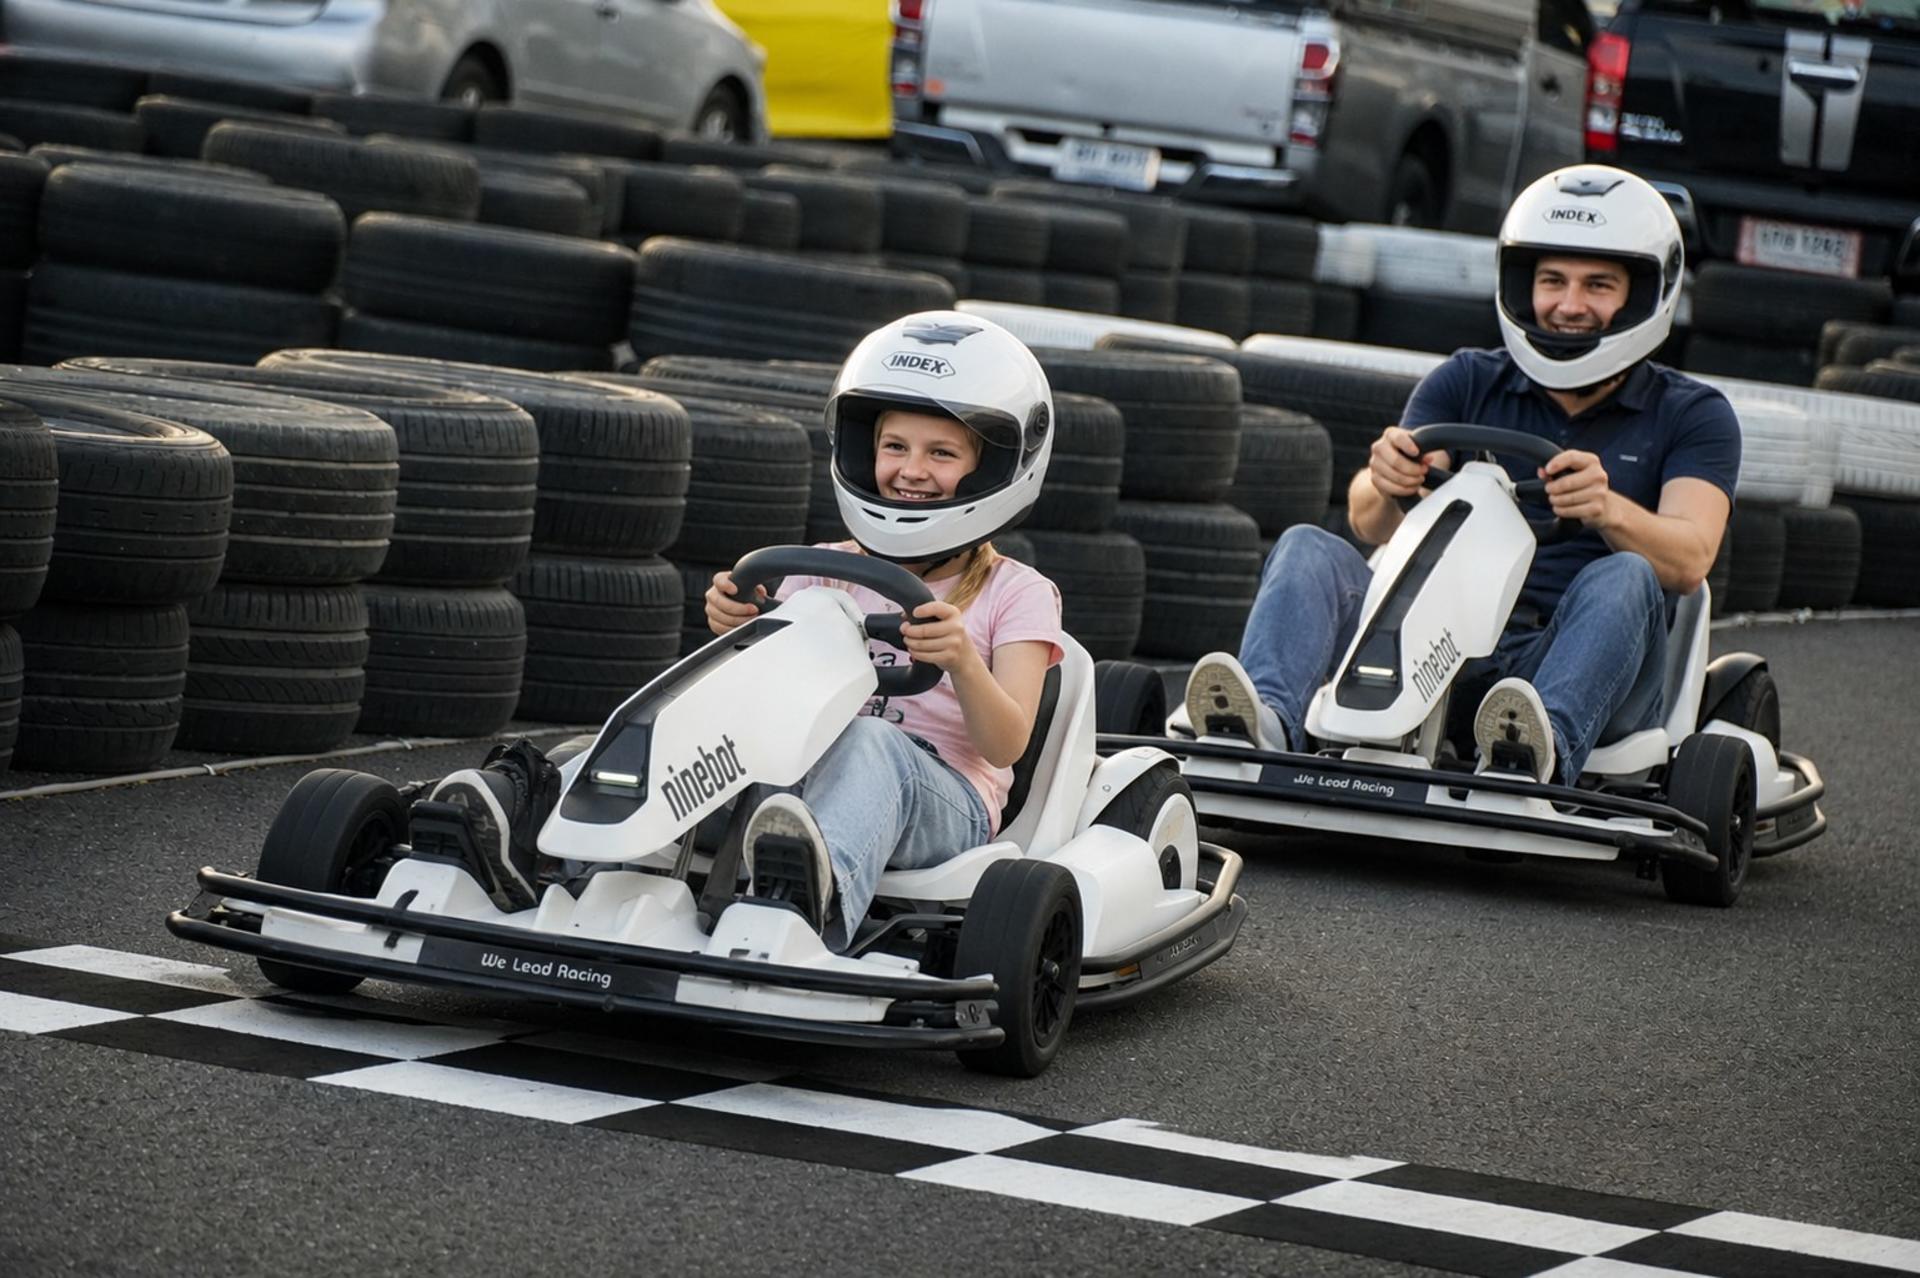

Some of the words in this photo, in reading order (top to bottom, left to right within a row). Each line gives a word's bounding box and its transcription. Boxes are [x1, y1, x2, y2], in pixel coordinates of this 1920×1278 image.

[1551, 209, 1597, 225] INDEX
[890, 354, 946, 374] INDEX
[1412, 626, 1461, 704] ninebot
[661, 733, 747, 822] ninebot
[1318, 775, 1351, 789] Lead
[1352, 779, 1395, 798] Racing
[481, 952, 507, 969] We
[512, 957, 554, 976] Lead
[556, 963, 612, 989] Racing
